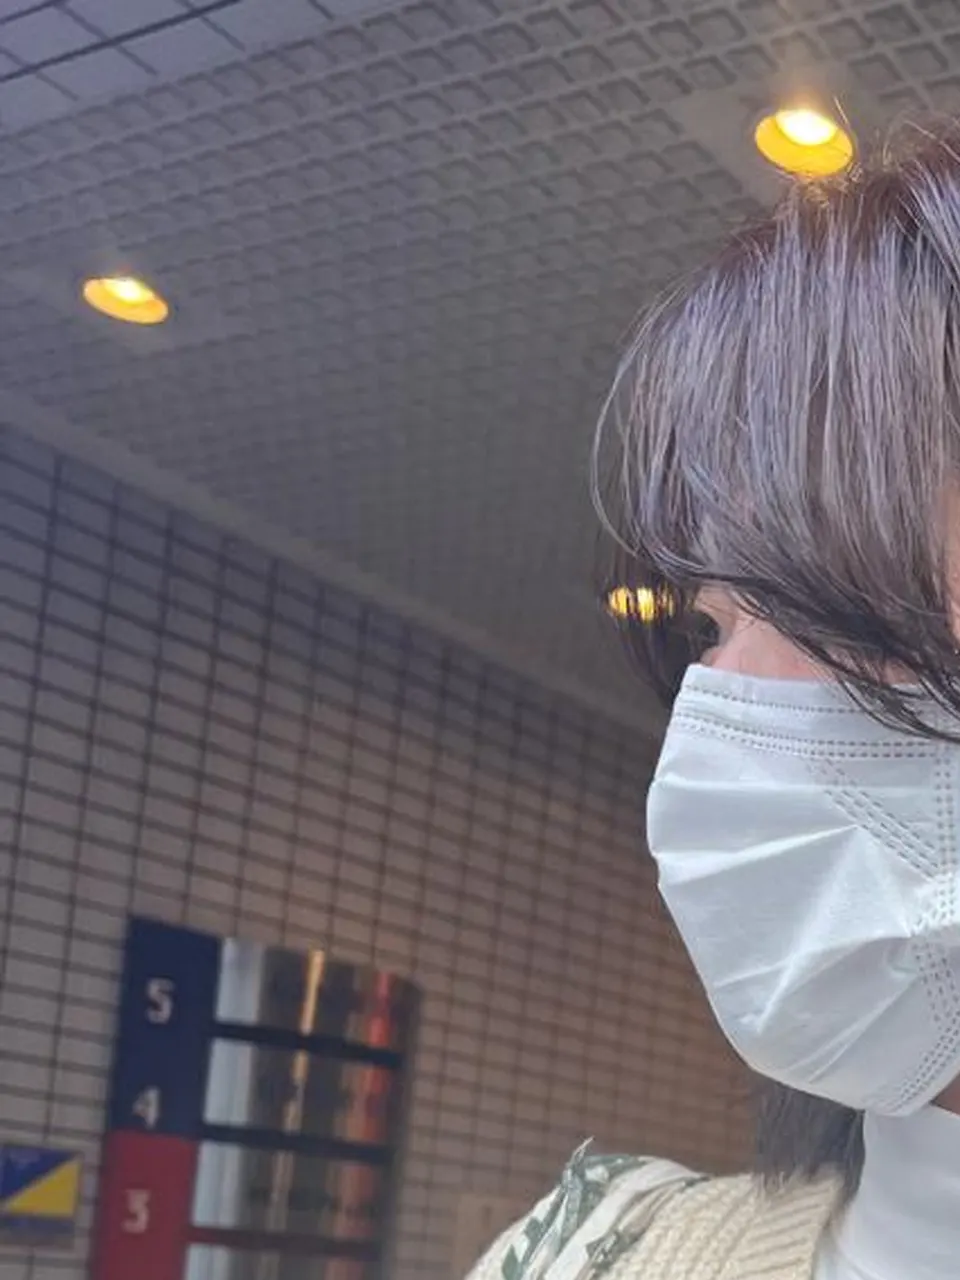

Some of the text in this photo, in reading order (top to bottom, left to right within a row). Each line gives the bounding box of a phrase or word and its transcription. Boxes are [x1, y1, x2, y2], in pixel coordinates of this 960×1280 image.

[145, 977, 175, 1025] 5
[132, 1085, 161, 1130] 4
[122, 1188, 150, 1235] 3
